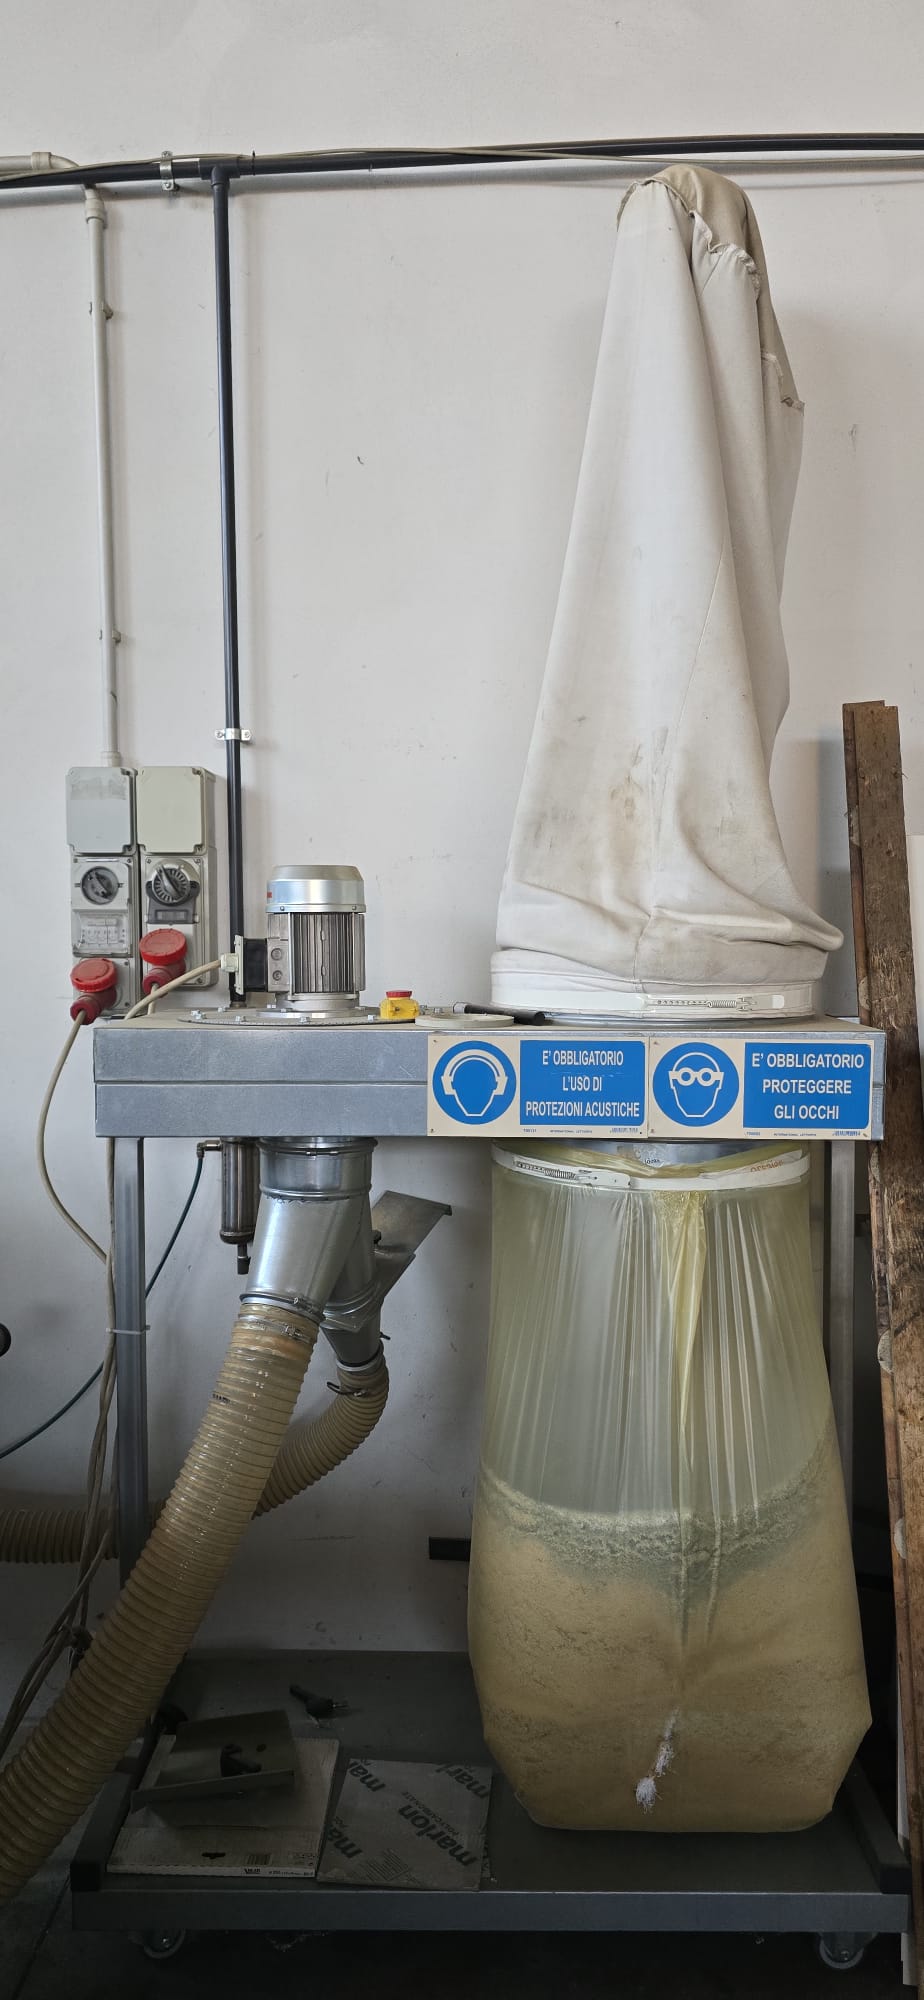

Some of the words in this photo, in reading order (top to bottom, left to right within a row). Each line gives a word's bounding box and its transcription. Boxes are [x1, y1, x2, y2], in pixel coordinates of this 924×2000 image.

[554, 1050, 624, 1066] OBBLIGATORIO
[766, 1053, 865, 1069] OBBLIGATORIO
[562, 1075, 591, 1092] L'USO
[592, 1076, 602, 1092] DI
[762, 1078, 852, 1095] PROTEGGERE
[525, 1100, 583, 1117] PROTEZIONI
[584, 1101, 640, 1117] ACUSTICHE
[774, 1104, 795, 1120] GLI
[798, 1104, 839, 1120] OCCHI
[397, 1804, 479, 1867] marlon
